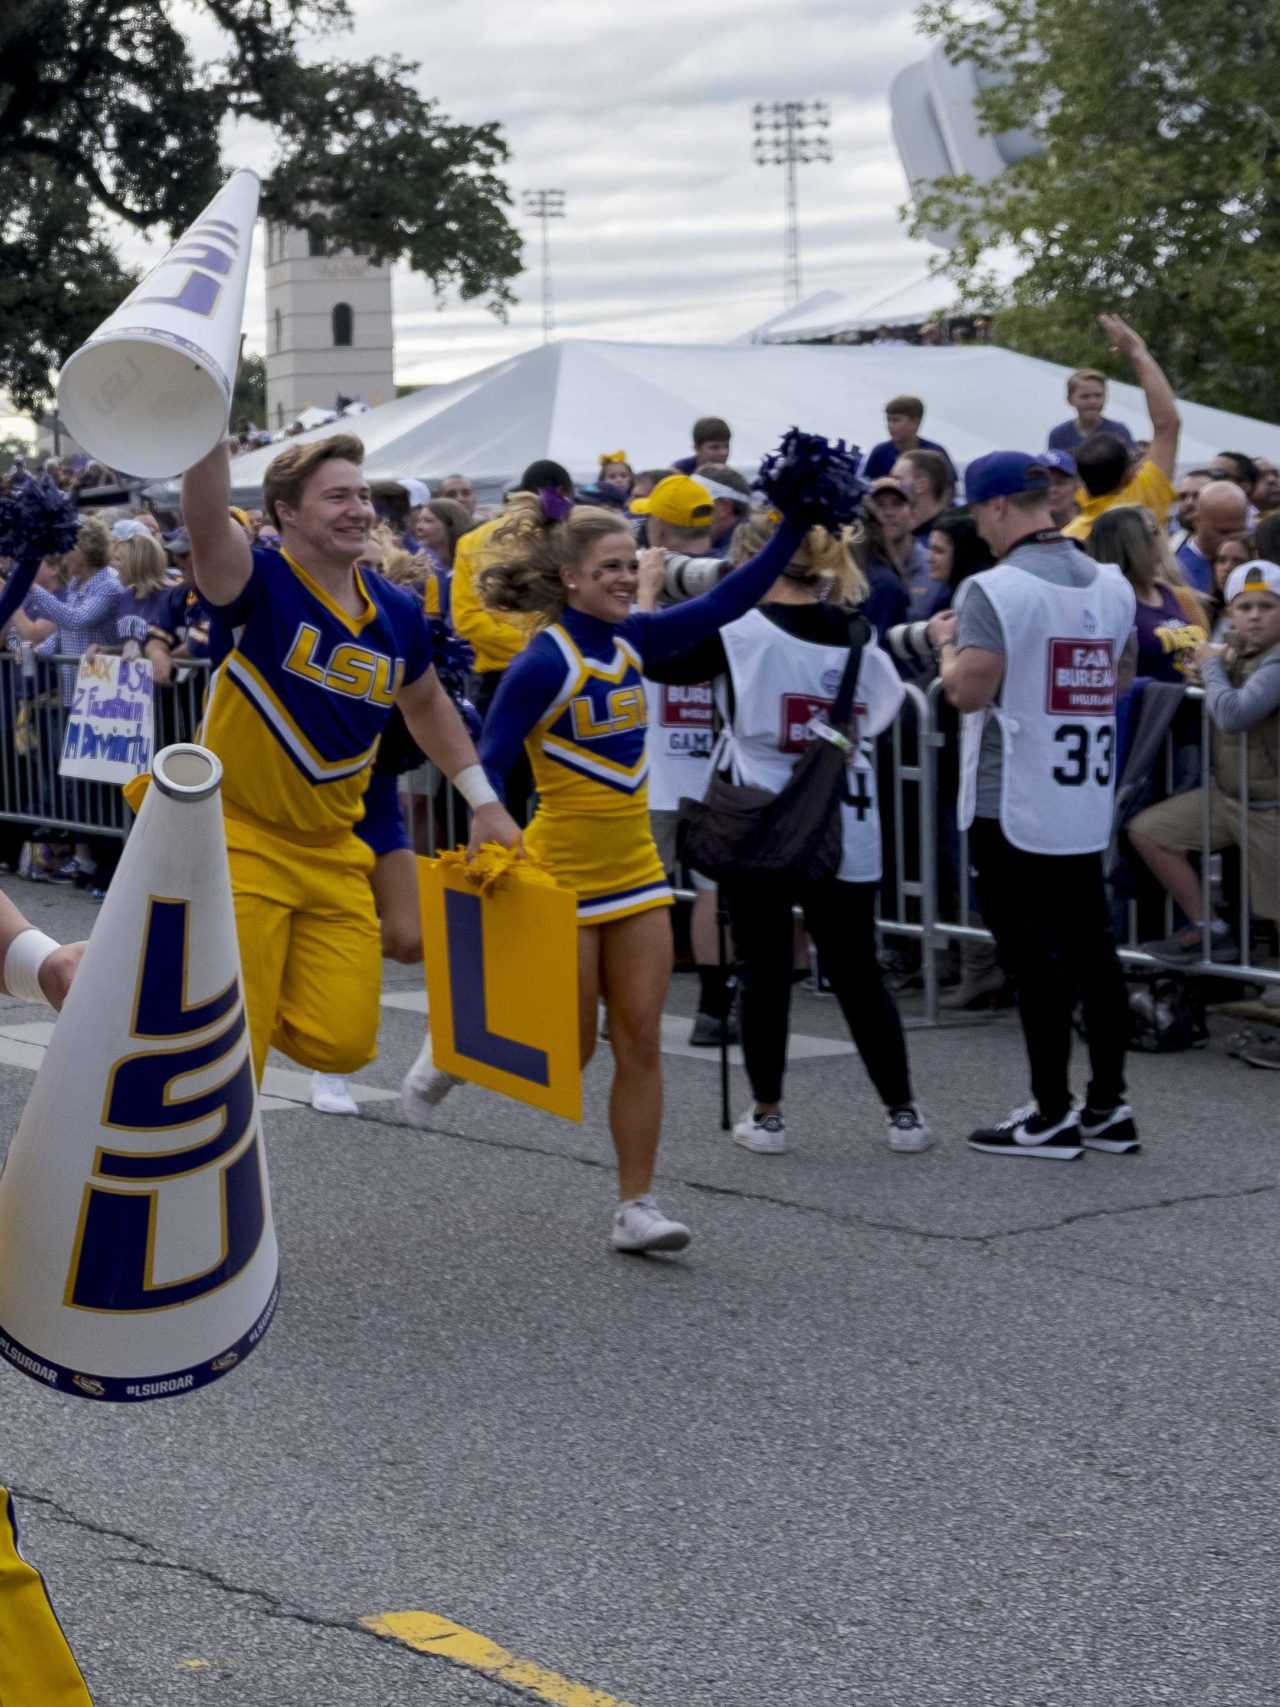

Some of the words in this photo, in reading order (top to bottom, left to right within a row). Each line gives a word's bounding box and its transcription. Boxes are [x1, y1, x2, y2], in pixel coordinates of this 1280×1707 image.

[281, 621, 405, 709] LSU
[1055, 668, 1115, 688] BUREA
[669, 732, 712, 751] GAM
[1052, 724, 1115, 787] 33
[443, 886, 551, 1089] L
[63, 893, 267, 1315] LSU
[125, 1374, 195, 1398] #LSUROAR
